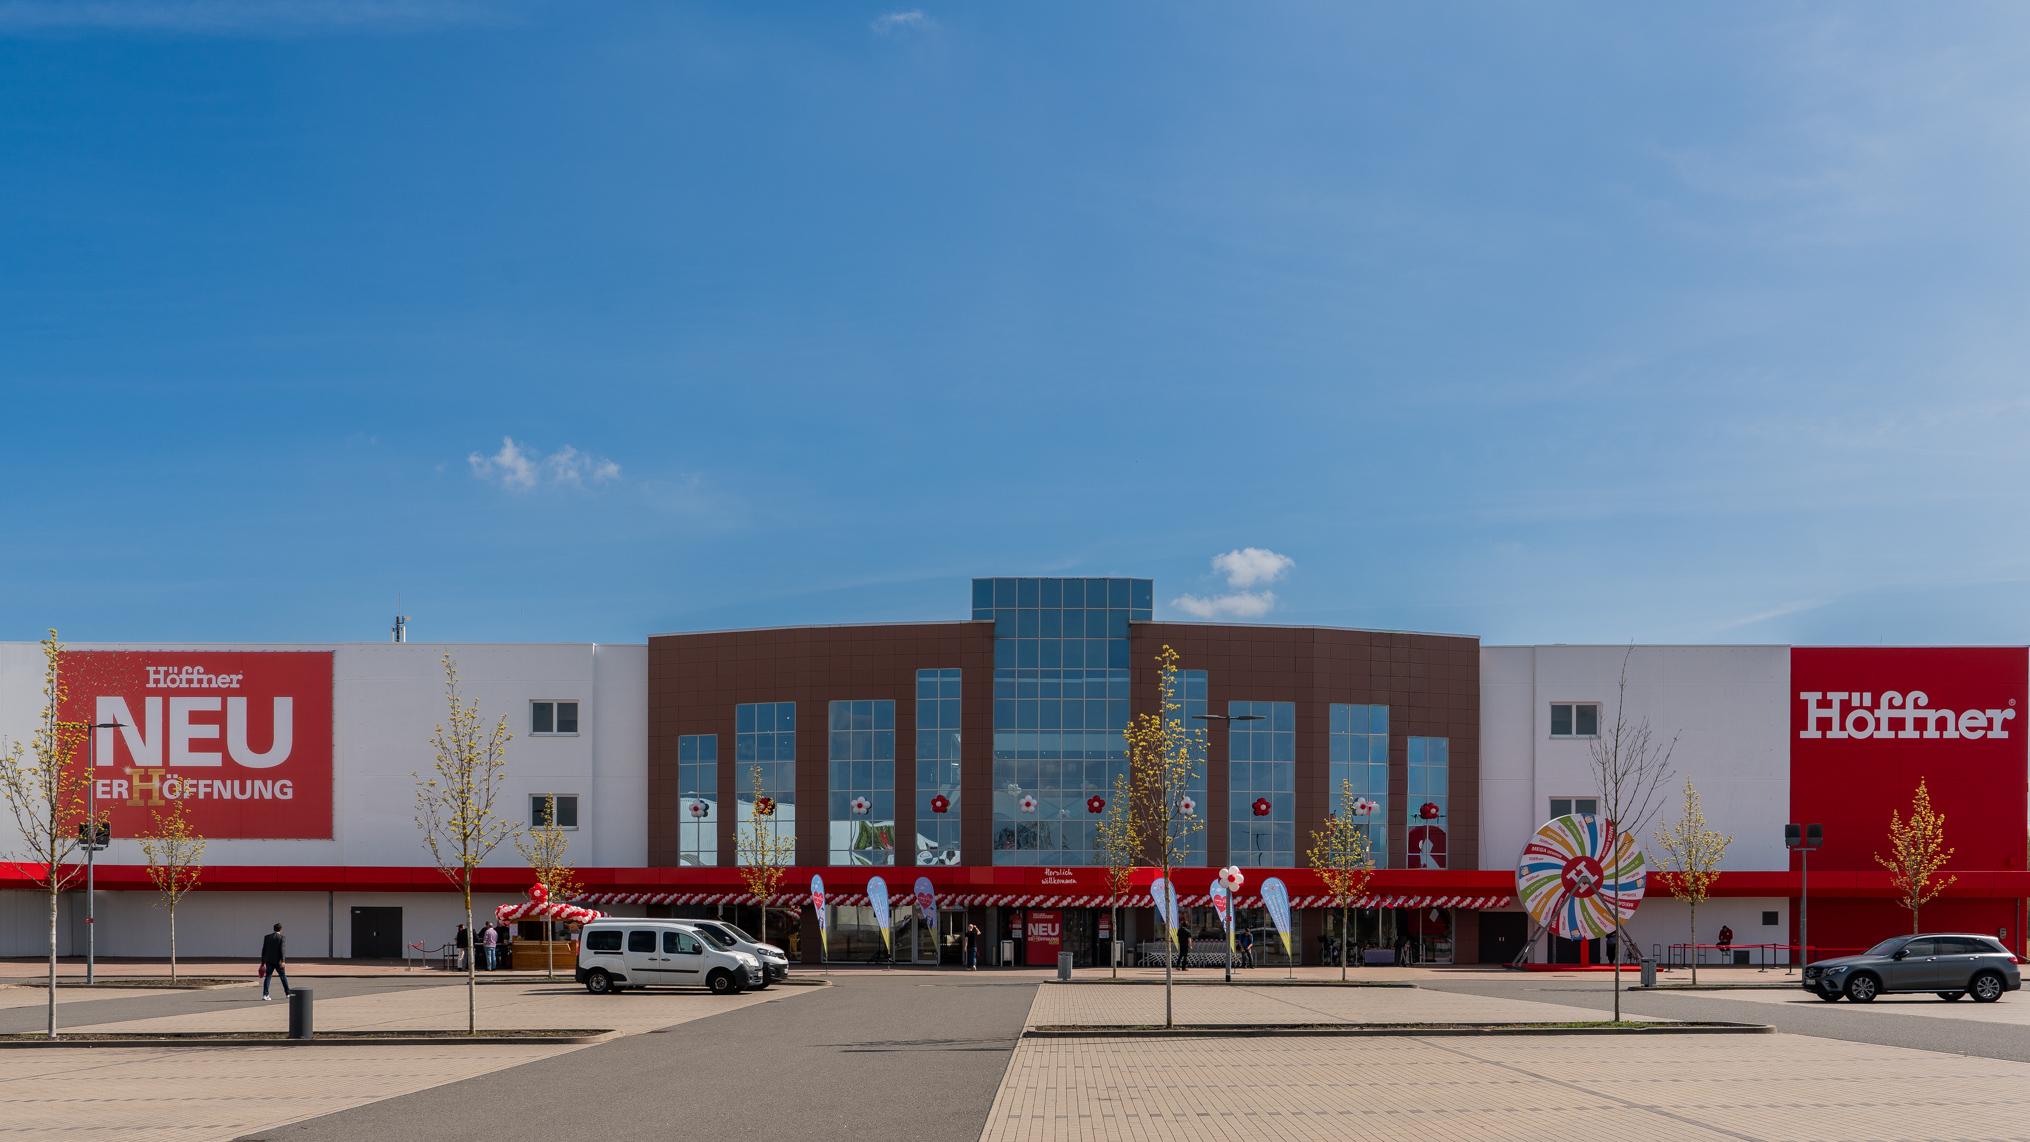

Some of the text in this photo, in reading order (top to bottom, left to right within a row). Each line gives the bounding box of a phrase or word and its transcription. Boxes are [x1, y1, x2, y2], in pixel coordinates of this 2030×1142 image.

[146, 666, 243, 688] Höffner
[1800, 690, 2016, 739] Höffner
[96, 696, 293, 769] NEU
[1028, 923, 1060, 936] NEU
